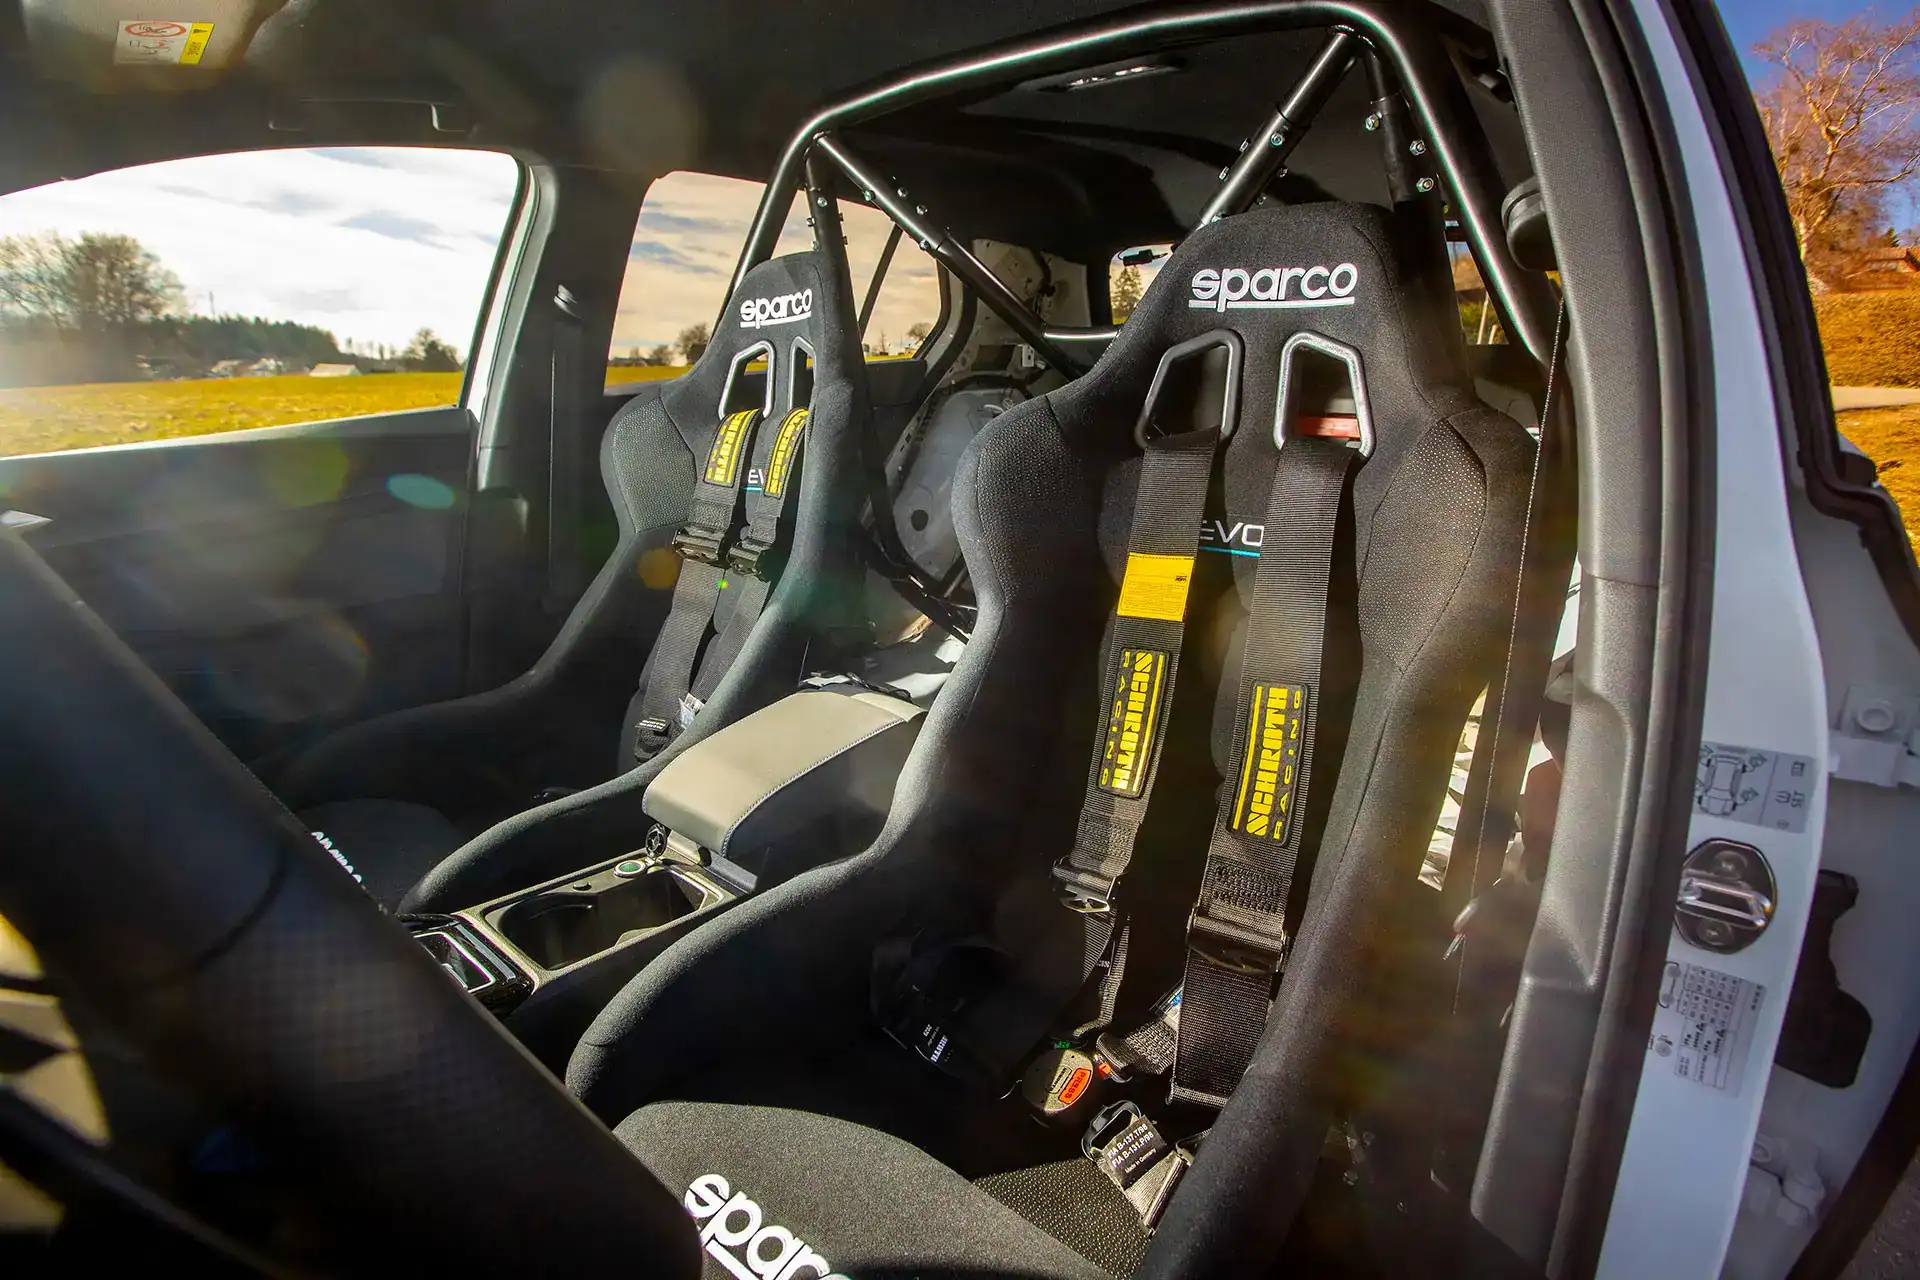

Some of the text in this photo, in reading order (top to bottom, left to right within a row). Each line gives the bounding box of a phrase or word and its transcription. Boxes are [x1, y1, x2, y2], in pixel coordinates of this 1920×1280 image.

[740, 288, 812, 328] sparco
[1190, 263, 1358, 312] sparco
[1101, 651, 1130, 785] RACING
[1111, 652, 1152, 789] SCHROTH
[1246, 687, 1288, 836] SCHROTH
[1273, 690, 1301, 839] RACING
[1107, 1145, 1119, 1159] FIA
[1112, 1155, 1125, 1167] FIA
[685, 1174, 852, 1280] spar
